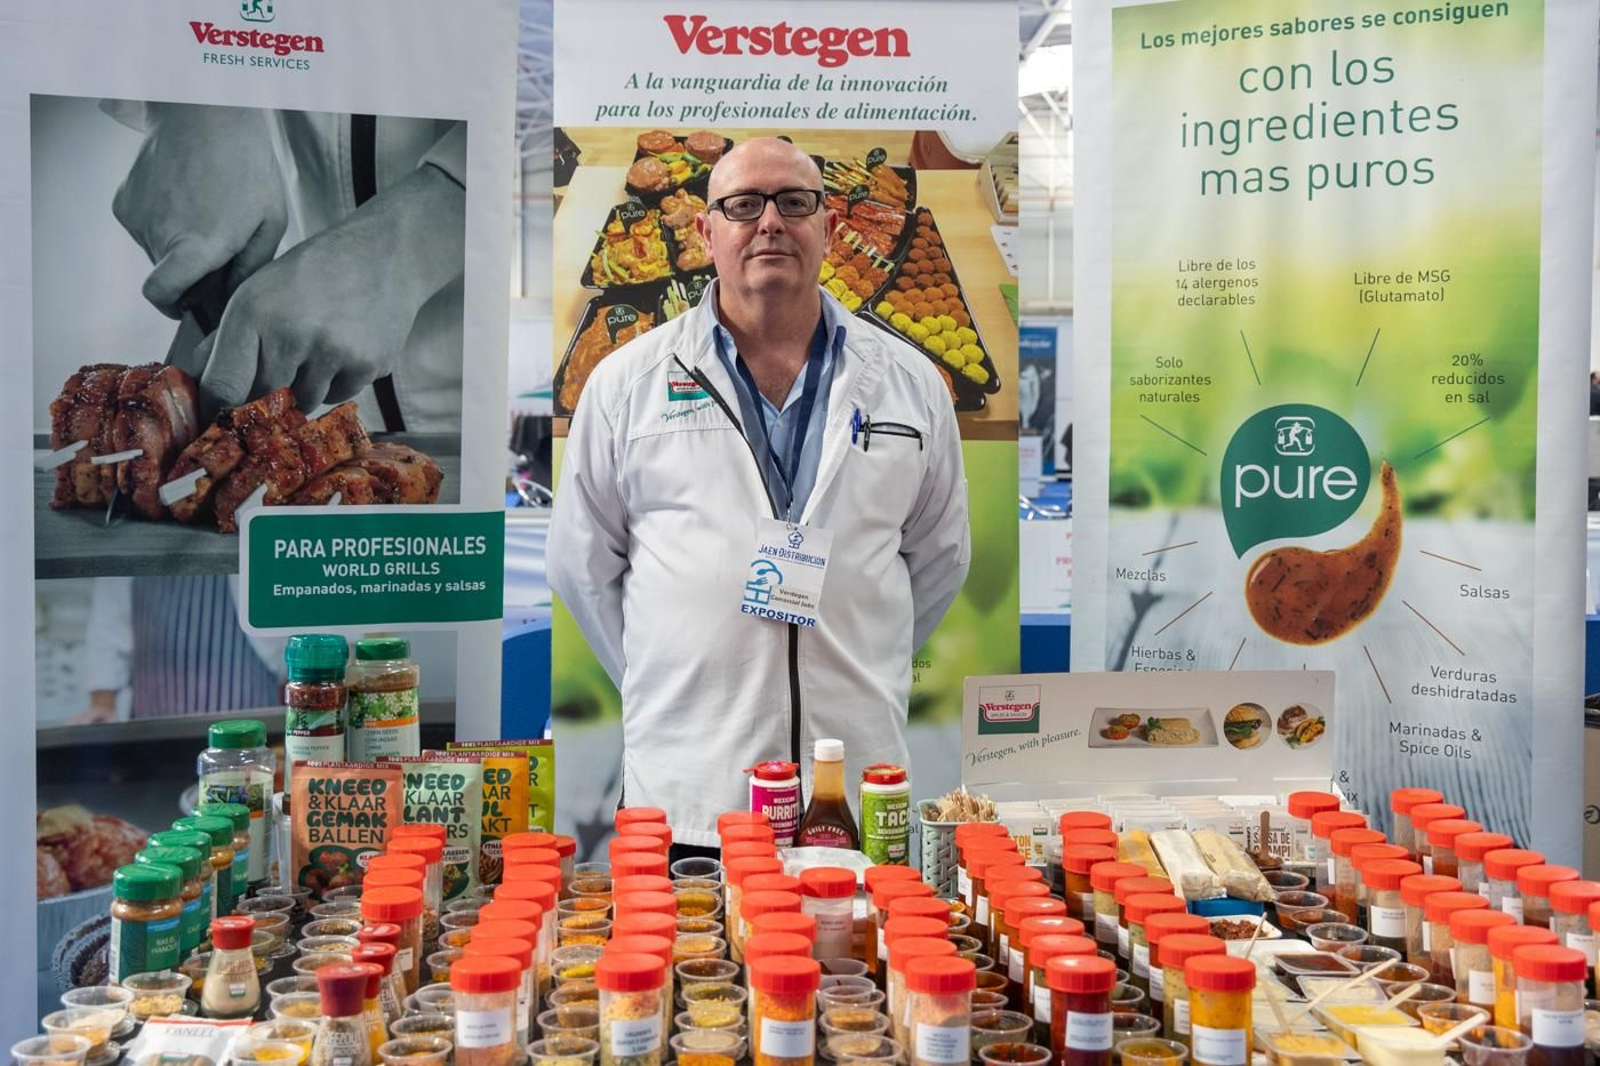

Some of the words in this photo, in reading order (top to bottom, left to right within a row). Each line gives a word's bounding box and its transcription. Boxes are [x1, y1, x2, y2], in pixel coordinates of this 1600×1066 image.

[1141, 32, 1176, 50] Los
[1181, 23, 1264, 46] mejores
[1270, 14, 1355, 36] sabores
[1361, 12, 1386, 30] se
[1393, 0, 1509, 26] consiguen
[189, 21, 324, 56] Verstegen
[664, 15, 911, 68] Verstegen
[203, 53, 244, 66] FRESH
[249, 56, 310, 70] SERVICES
[1239, 63, 1312, 94] con
[1332, 50, 1395, 86] los
[624, 74, 640, 90] A
[646, 73, 664, 90] la
[671, 73, 782, 94] vanguardia
[788, 74, 809, 91] de
[816, 74, 834, 92] la
[840, 74, 948, 93] innovación
[596, 104, 640, 122] para
[648, 101, 674, 118] los
[679, 102, 810, 122] profesionales
[816, 102, 838, 120] de
[844, 102, 978, 122] alimentación.
[1181, 100, 1460, 156] ingredientes
[1201, 164, 1290, 196] mas
[1308, 156, 1435, 201] puros
[621, 210, 646, 220] pure
[1178, 260, 1212, 272] Libre
[1216, 259, 1233, 272] de
[1237, 258, 1256, 271] los
[1176, 278, 1188, 290] 14
[1192, 276, 1260, 292] alergenos
[1354, 272, 1392, 286] Libre
[1395, 271, 1413, 284] de
[1418, 270, 1451, 284] MSG
[1177, 292, 1256, 307] declarables
[1358, 288, 1446, 304] (Glutamato)
[607, 313, 636, 326] pure
[1156, 356, 1184, 370] Solo
[1452, 354, 1484, 368] 20%
[1130, 372, 1212, 386] saborizantes
[1431, 372, 1505, 386] reducidos
[1139, 390, 1200, 404] naturales
[1444, 392, 1462, 404] en
[1468, 390, 1490, 404] sal
[1235, 464, 1358, 508] pure
[274, 538, 326, 559] PARA
[332, 536, 486, 558] PROFESIONALES
[322, 563, 380, 578] WORLD
[384, 562, 440, 576] GRILLS
[1116, 568, 1166, 582] Mezclas
[274, 582, 357, 598] Empanados,
[360, 581, 431, 594] marinadas
[434, 582, 442, 594] y
[445, 580, 486, 592] salsas
[1460, 584, 1510, 600] Salsas
[741, 604, 816, 627] EXPOSITOR
[1132, 646, 1182, 660] Hierbas
[1186, 649, 1196, 661] &
[912, 658, 932, 668] dos
[1430, 666, 1498, 684] Verduras
[1410, 682, 1518, 704] deshidratadas
[985, 703, 1032, 712] Verstegen
[1018, 738, 1039, 750] with
[1041, 729, 1082, 748] pleasure.
[1389, 722, 1467, 742] Marinadas
[1472, 728, 1482, 743] &
[1400, 740, 1440, 758] Spice
[1444, 742, 1472, 760] Oils
[1339, 770, 1350, 784] &
[308, 778, 387, 796] KNEED
[308, 796, 322, 810] &
[325, 796, 386, 811] KLAAR
[405, 790, 464, 806] KLAAR
[1342, 788, 1358, 803] ix
[403, 805, 466, 823] LANT
[762, 803, 800, 820] BURRIT
[306, 812, 388, 828] GEMAK
[310, 828, 384, 844] BALLEN
[1253, 832, 1278, 844] SSA
[1280, 832, 1290, 844] DE
